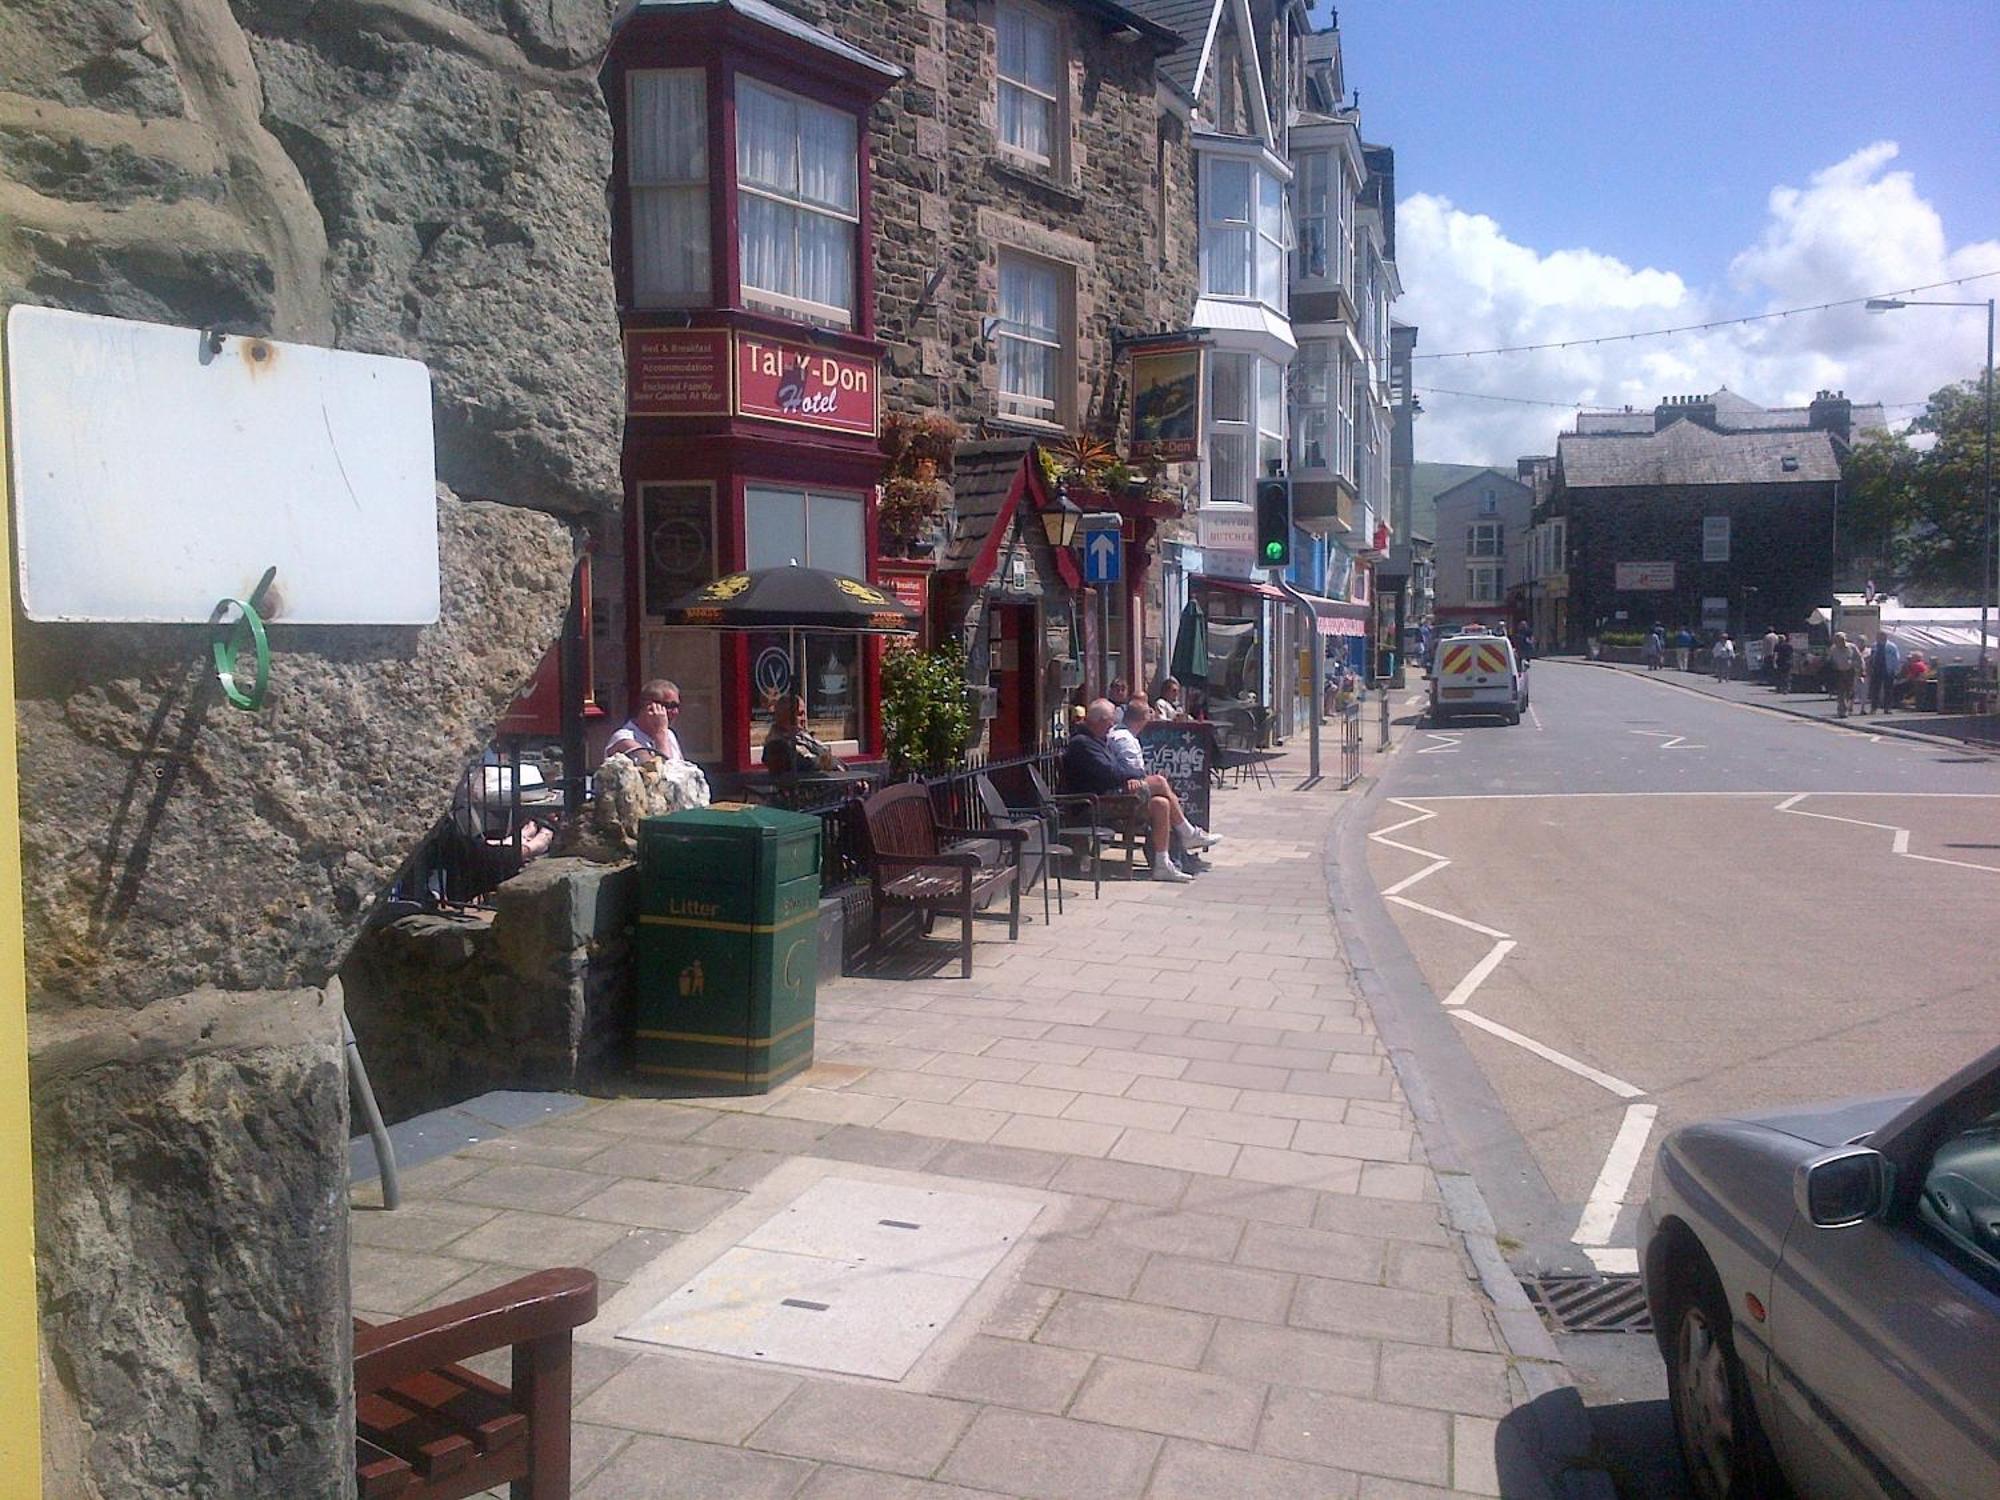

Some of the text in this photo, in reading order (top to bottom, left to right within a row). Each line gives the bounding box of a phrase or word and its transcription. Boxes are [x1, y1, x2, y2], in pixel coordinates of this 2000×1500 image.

[671, 343, 713, 353] Breakfast
[641, 361, 714, 372] Accommodation
[683, 382, 713, 393] Family
[778, 384, 838, 414] Hotel
[1142, 744, 1205, 767] EVENING
[669, 896, 721, 917] Litter
